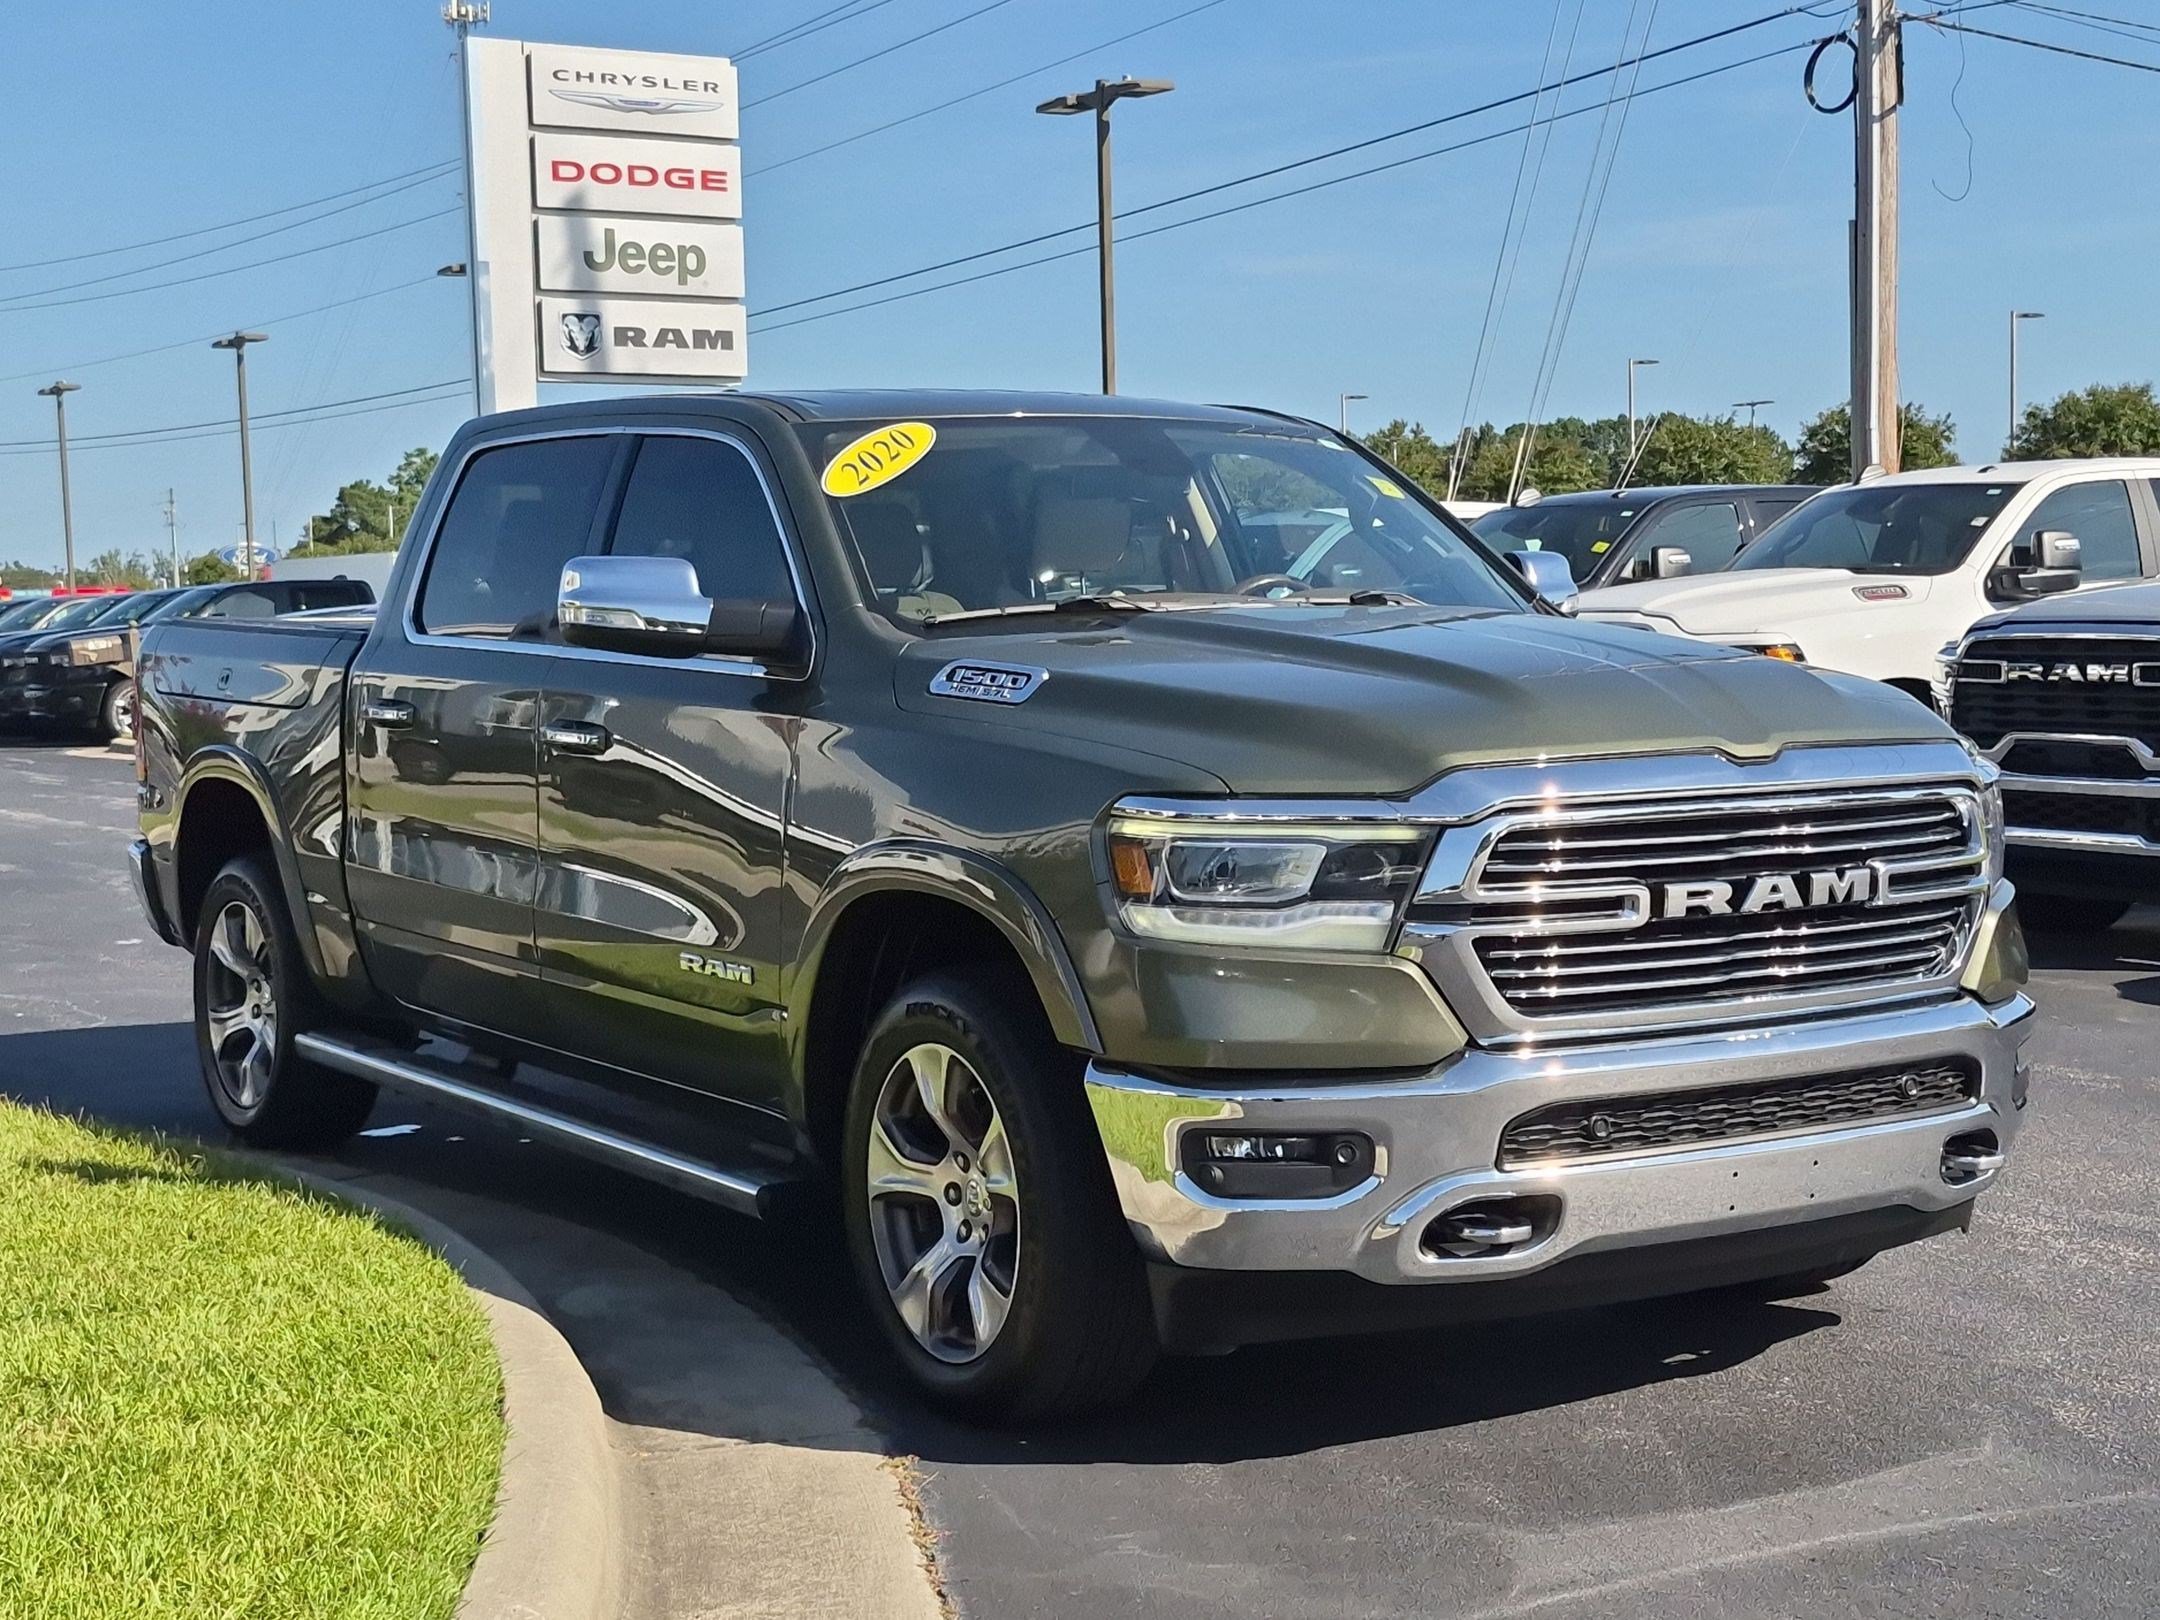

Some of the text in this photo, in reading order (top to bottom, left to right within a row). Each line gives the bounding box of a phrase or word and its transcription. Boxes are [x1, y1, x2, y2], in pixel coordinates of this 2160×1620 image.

[552, 69, 720, 93] CHRYSLER
[551, 160, 728, 192] DODGE
[583, 228, 707, 286] Jeep
[613, 326, 734, 351] RAM
[841, 429, 915, 486] 2020
[952, 668, 1028, 689] 1500
[2006, 662, 2129, 684] RAM
[949, 683, 1010, 699] HEMI 5.7L
[1663, 867, 1871, 918] RAM
[679, 951, 754, 986] RAM
